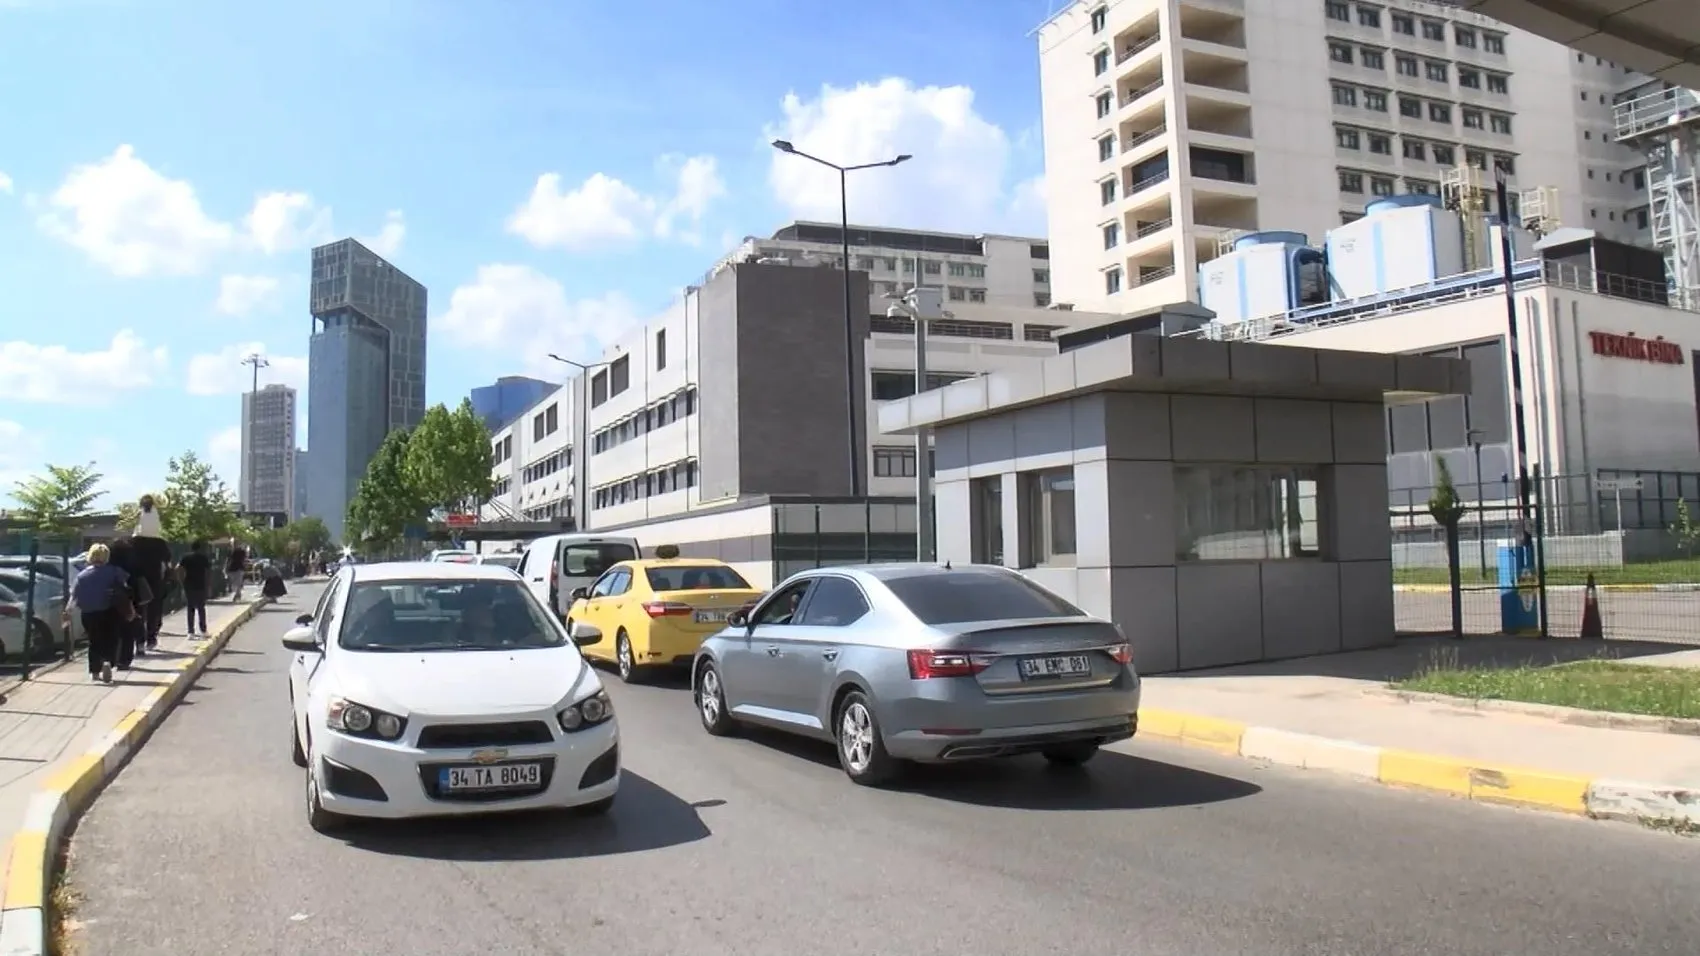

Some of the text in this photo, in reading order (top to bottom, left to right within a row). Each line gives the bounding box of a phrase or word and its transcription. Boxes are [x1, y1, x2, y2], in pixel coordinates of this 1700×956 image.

[1588, 331, 1685, 365] TEKNİK BİNA
[1025, 660, 1040, 675] 34
[451, 765, 537, 786] 34 TA 8049
